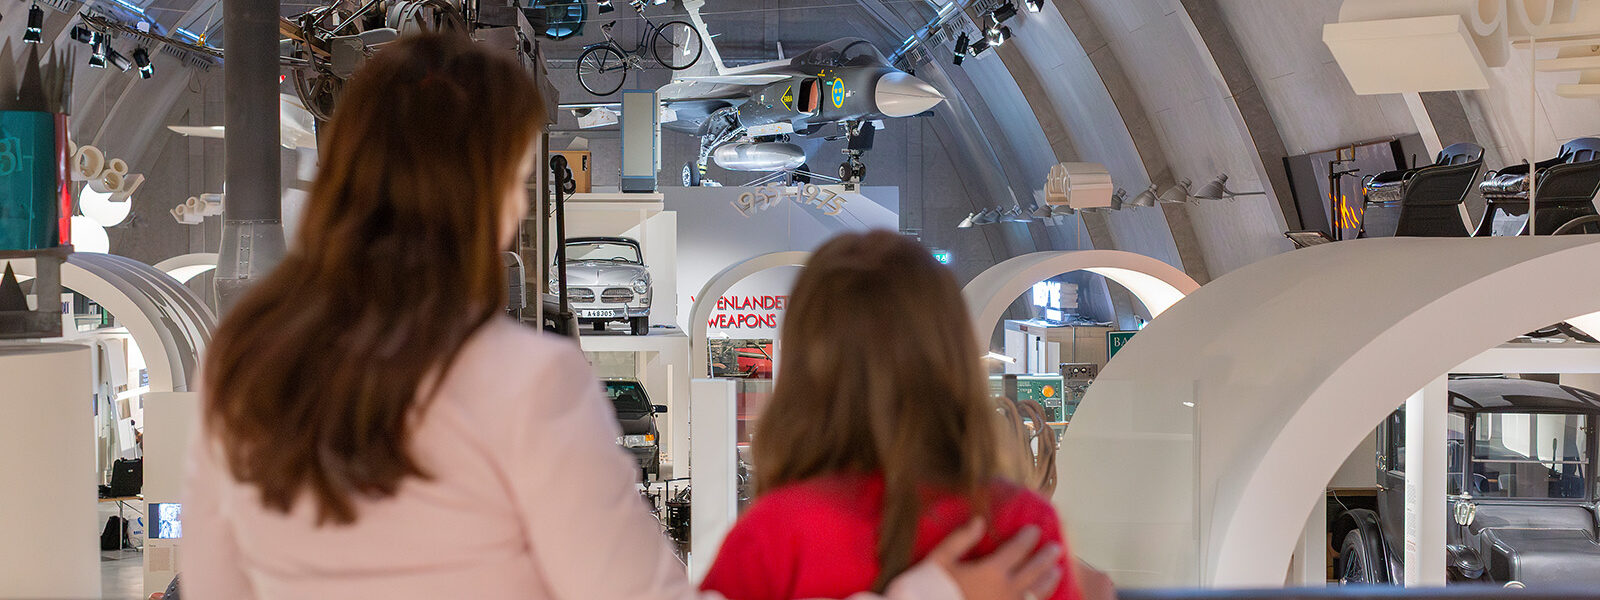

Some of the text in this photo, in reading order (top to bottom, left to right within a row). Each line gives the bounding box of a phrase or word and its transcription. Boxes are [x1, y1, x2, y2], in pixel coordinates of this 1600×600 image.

[683, 25, 691, 56] 2
[690, 295, 790, 310] ENLANDET
[707, 313, 777, 329] WEAPONS
